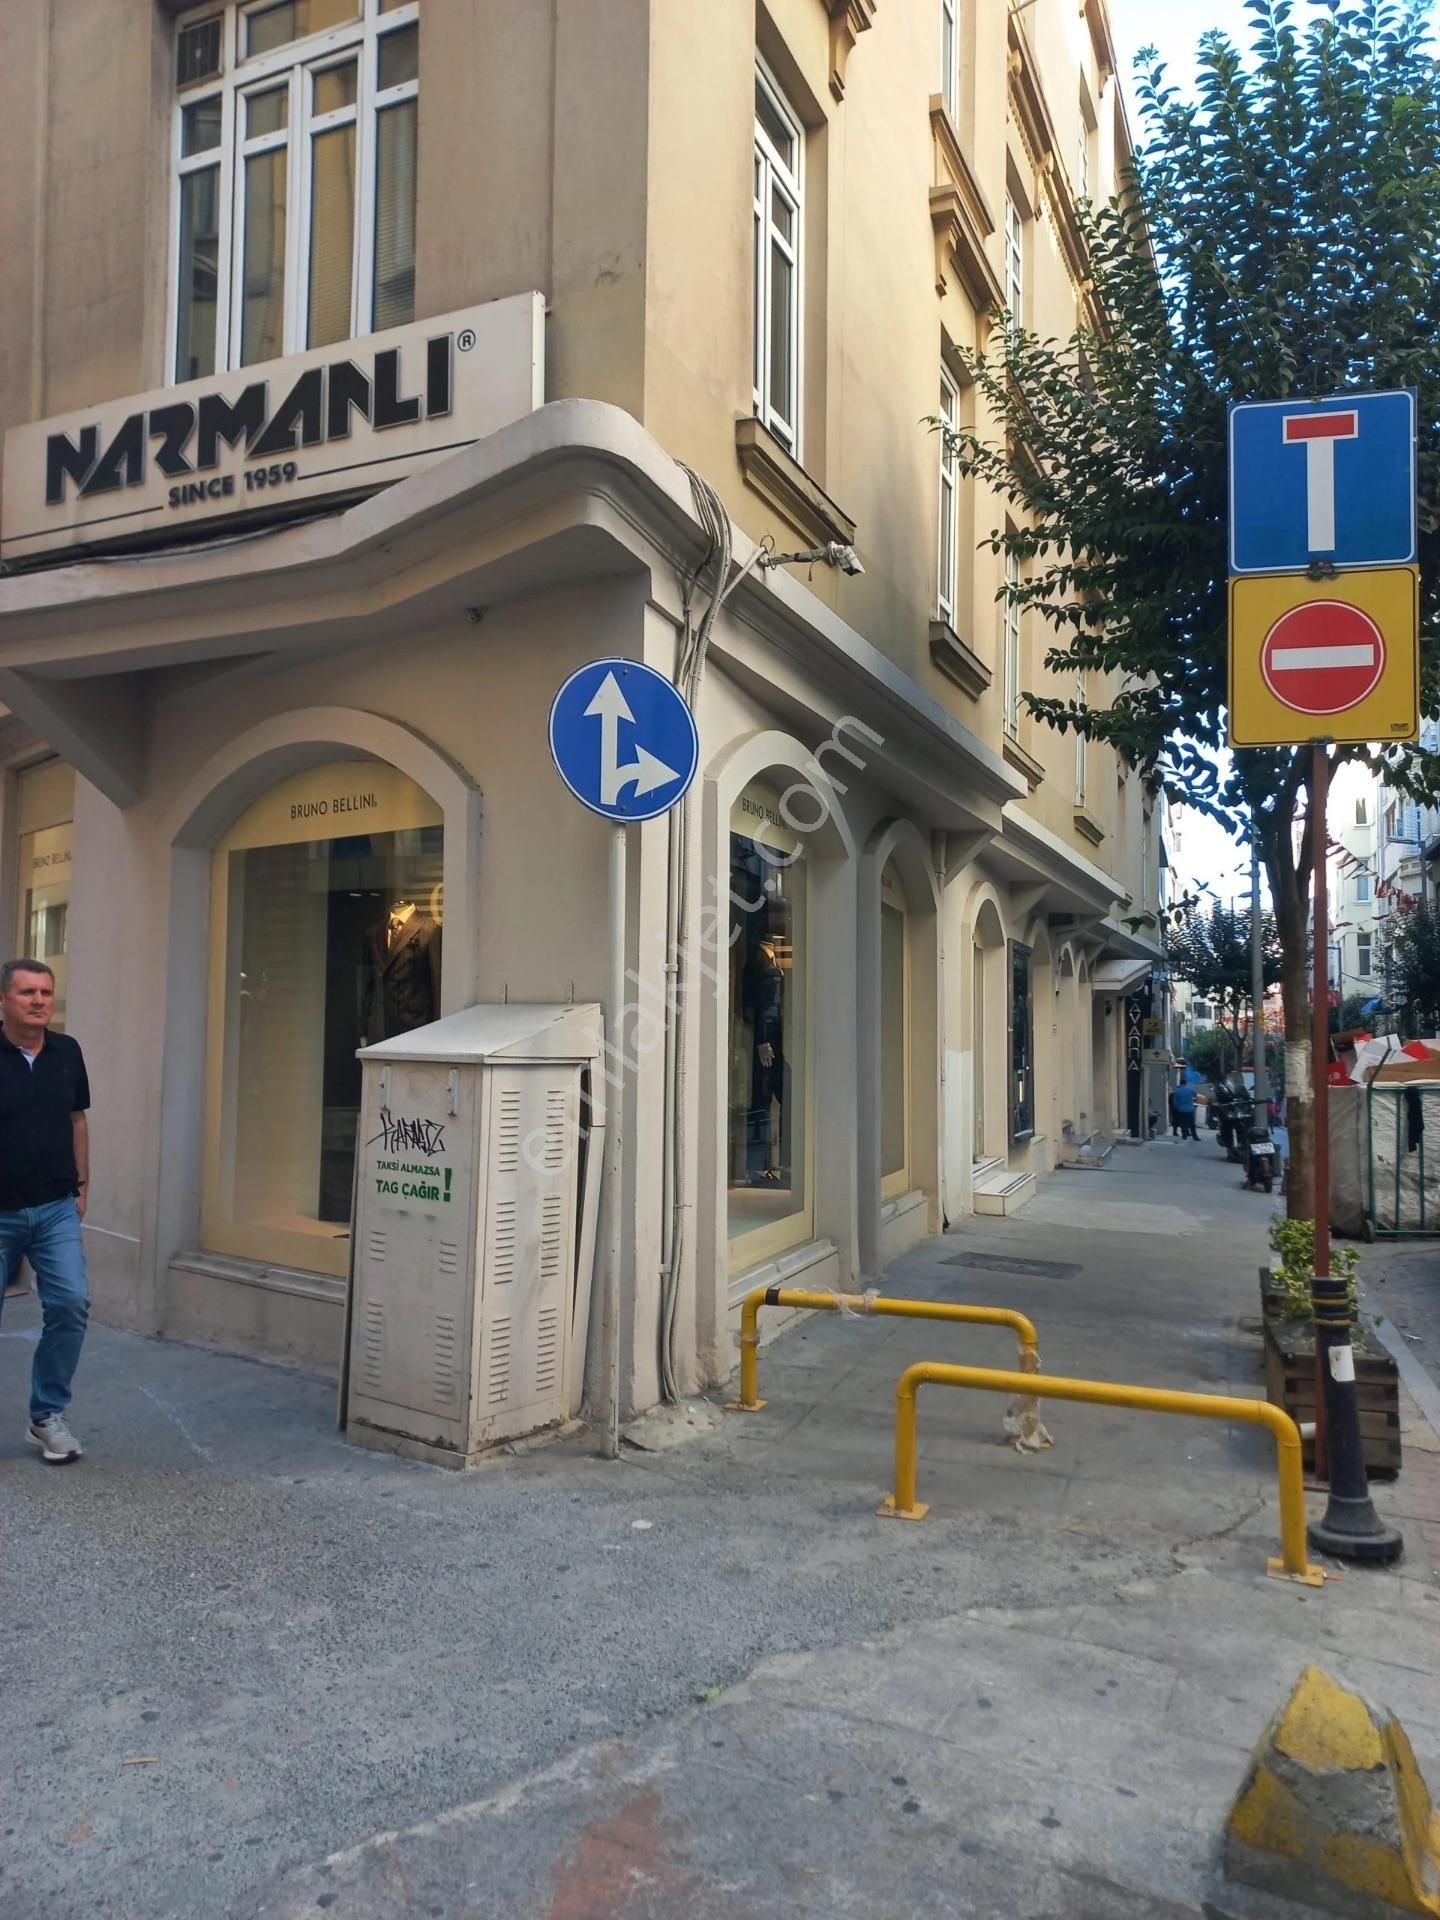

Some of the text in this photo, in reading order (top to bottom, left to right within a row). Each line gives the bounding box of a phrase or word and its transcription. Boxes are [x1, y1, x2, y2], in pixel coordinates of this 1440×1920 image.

[168, 461, 298, 510] SINCE 1959
[290, 800, 329, 820] BRUNO
[742, 797, 764, 819] BRUNO
[401, 1163, 441, 1177] ALMAZSA
[376, 1179, 399, 1195] TAG
